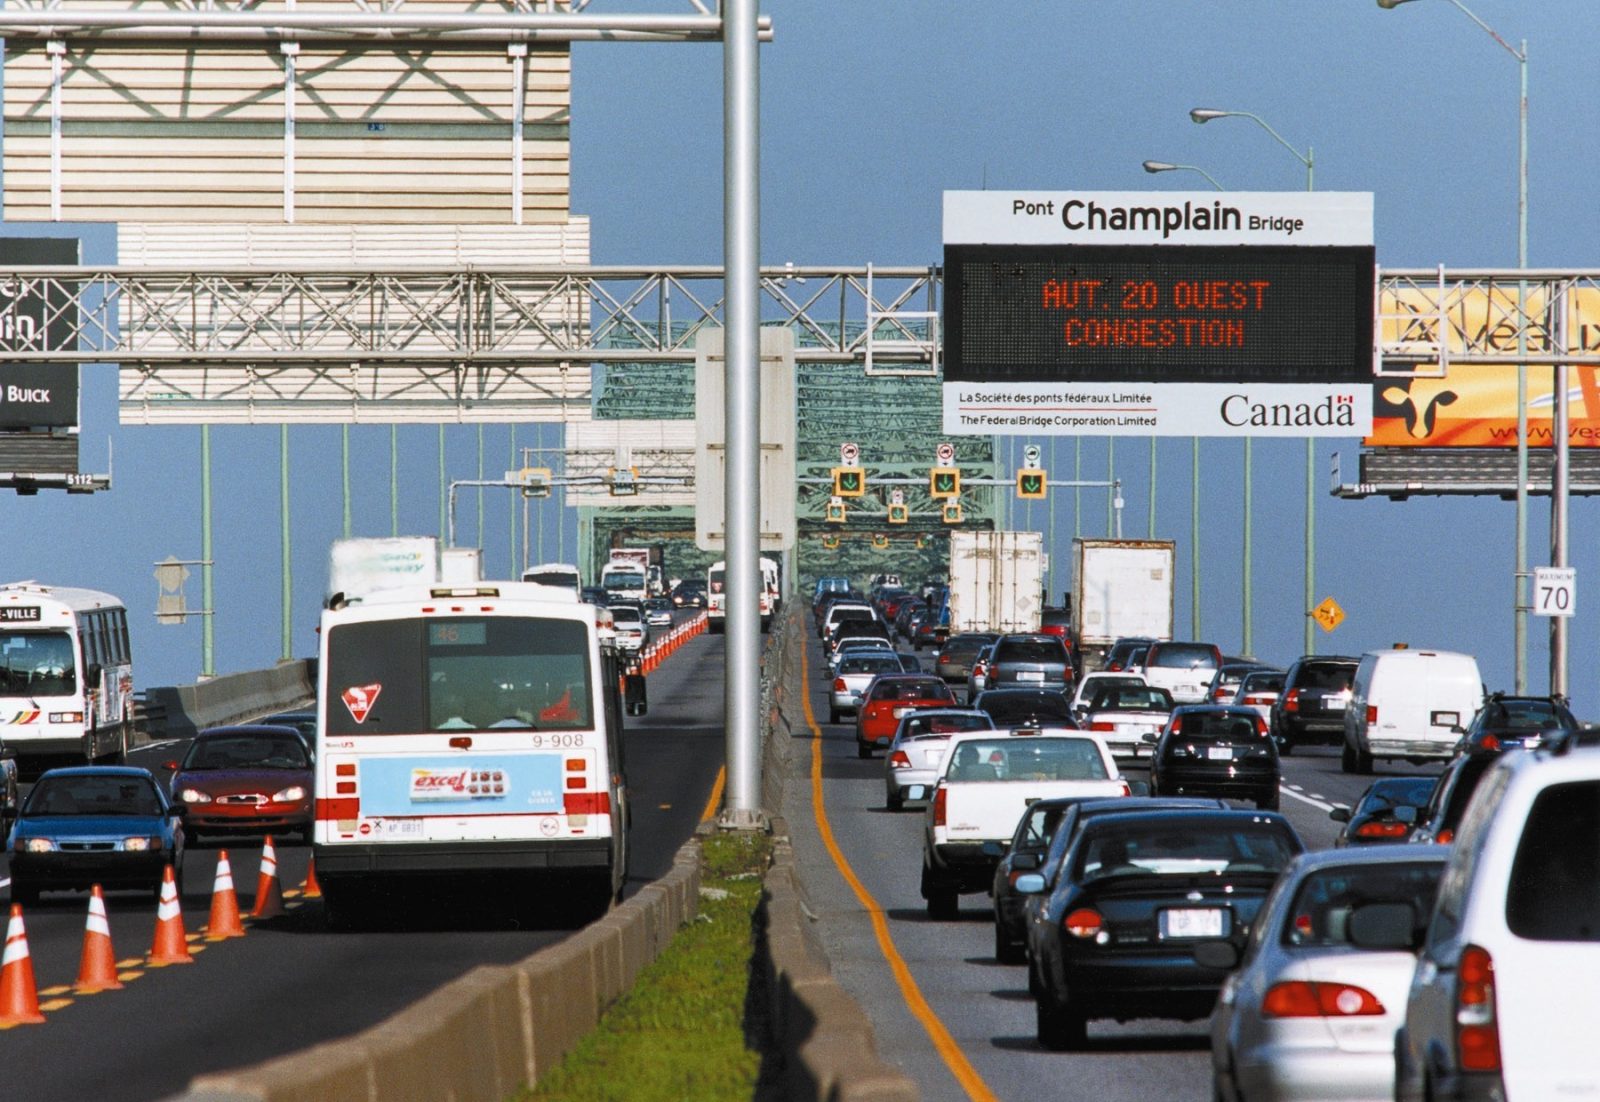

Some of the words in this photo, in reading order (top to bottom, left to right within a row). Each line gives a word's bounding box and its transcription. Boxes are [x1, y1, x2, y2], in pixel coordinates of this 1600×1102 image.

[1012, 199, 1055, 216] Pont
[1062, 199, 1242, 239] Champlain
[1249, 215, 1305, 236] Bridge
[1041, 278, 1110, 310] AUT.
[1121, 279, 1159, 310] 20
[1174, 279, 1271, 310] OUEST
[0, 308, 42, 340] in.
[1064, 318, 1245, 347] CONGESTION
[7, 384, 51, 403] BUICK
[959, 392, 974, 403] La
[975, 392, 1013, 403] Société
[1014, 393, 1032, 403] des
[1033, 393, 1063, 405] ponts
[1065, 393, 1110, 403] fédéraux
[1112, 393, 1152, 403] Limitée
[1220, 394, 1355, 427] Canada
[960, 415, 979, 425] The
[980, 415, 1018, 425] Federal
[1019, 415, 1053, 428] Bridge
[1054, 415, 1115, 427] Corporation
[1117, 416, 1157, 426] Limited
[67, 473, 92, 485] 5112
[1541, 586, 1569, 610] 70
[0, 608, 37, 620] -VILLE
[532, 733, 585, 748] 9-908
[414, 770, 467, 787] excel
